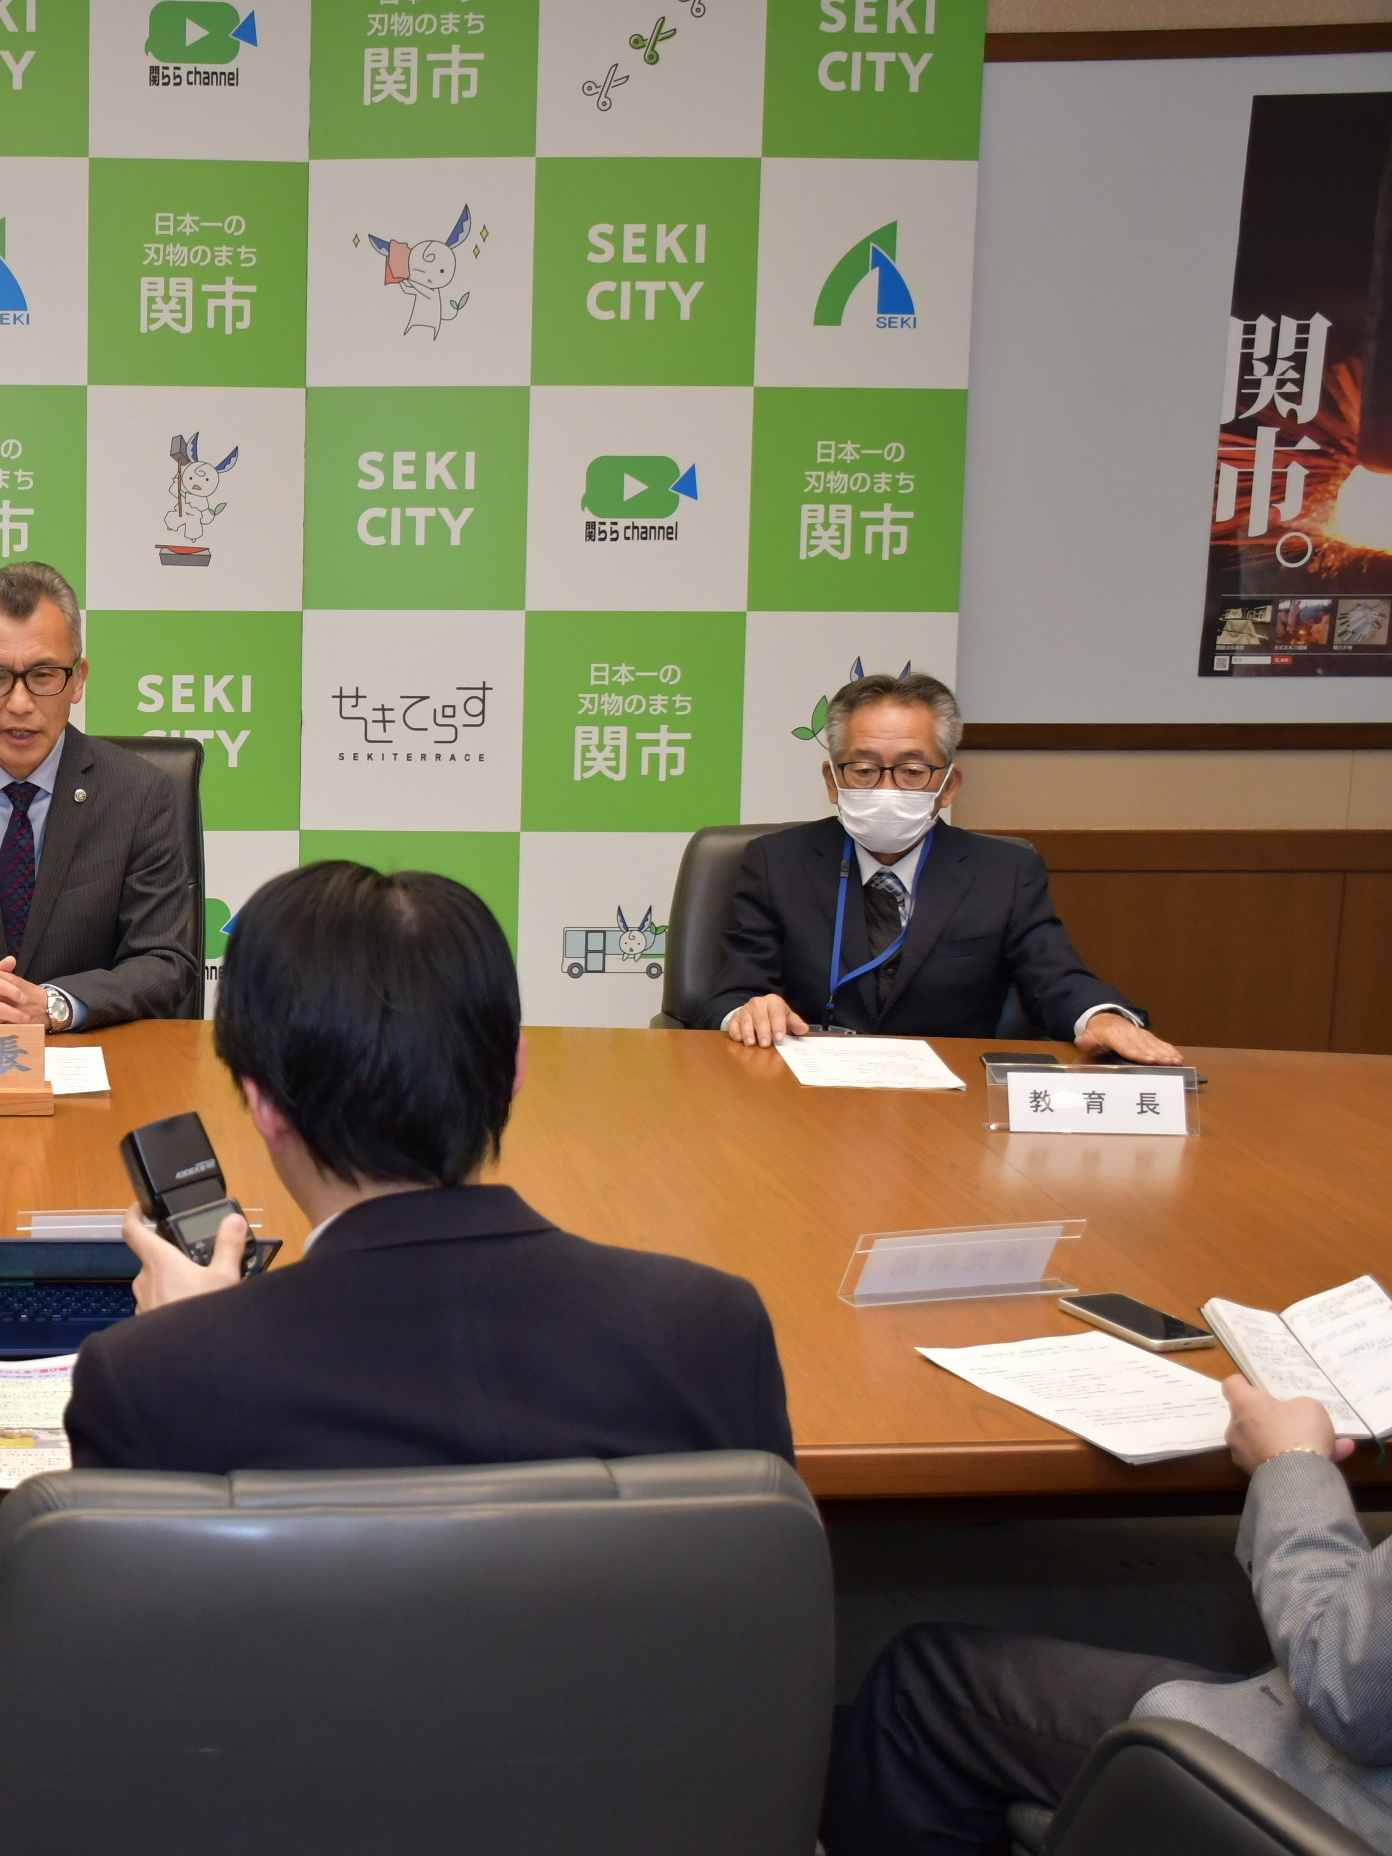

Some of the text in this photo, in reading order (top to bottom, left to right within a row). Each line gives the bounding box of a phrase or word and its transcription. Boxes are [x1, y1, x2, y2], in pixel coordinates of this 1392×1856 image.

[367, 12, 484, 36] 刃物のまち
[819, 0, 935, 34] SEKI
[149, 66, 238, 86] 関らら channel
[364, 45, 484, 105] 関市
[818, 51, 933, 92] CITY
[155, 213, 245, 236] 日本一の
[143, 243, 256, 267] 刃物のまち
[587, 224, 706, 263] SEKI
[140, 277, 257, 335] 関市
[587, 281, 704, 320] CITY
[876, 317, 916, 328] SEKI
[817, 440, 905, 463] 日本一の
[357, 451, 475, 490] SEKI
[804, 471, 914, 494] 刃物のまち
[357, 507, 474, 546] CITY
[585, 521, 678, 542] 関らら channel
[800, 503, 914, 560] 関市
[591, 663, 681, 685] 日本一の
[137, 675, 251, 712] SEKI
[578, 693, 692, 715] 刃物のまち
[332, 681, 493, 743] せきてらす
[142, 729, 252, 768] TY
[339, 753, 484, 761] SEKITERRACE
[574, 725, 691, 781] 関市
